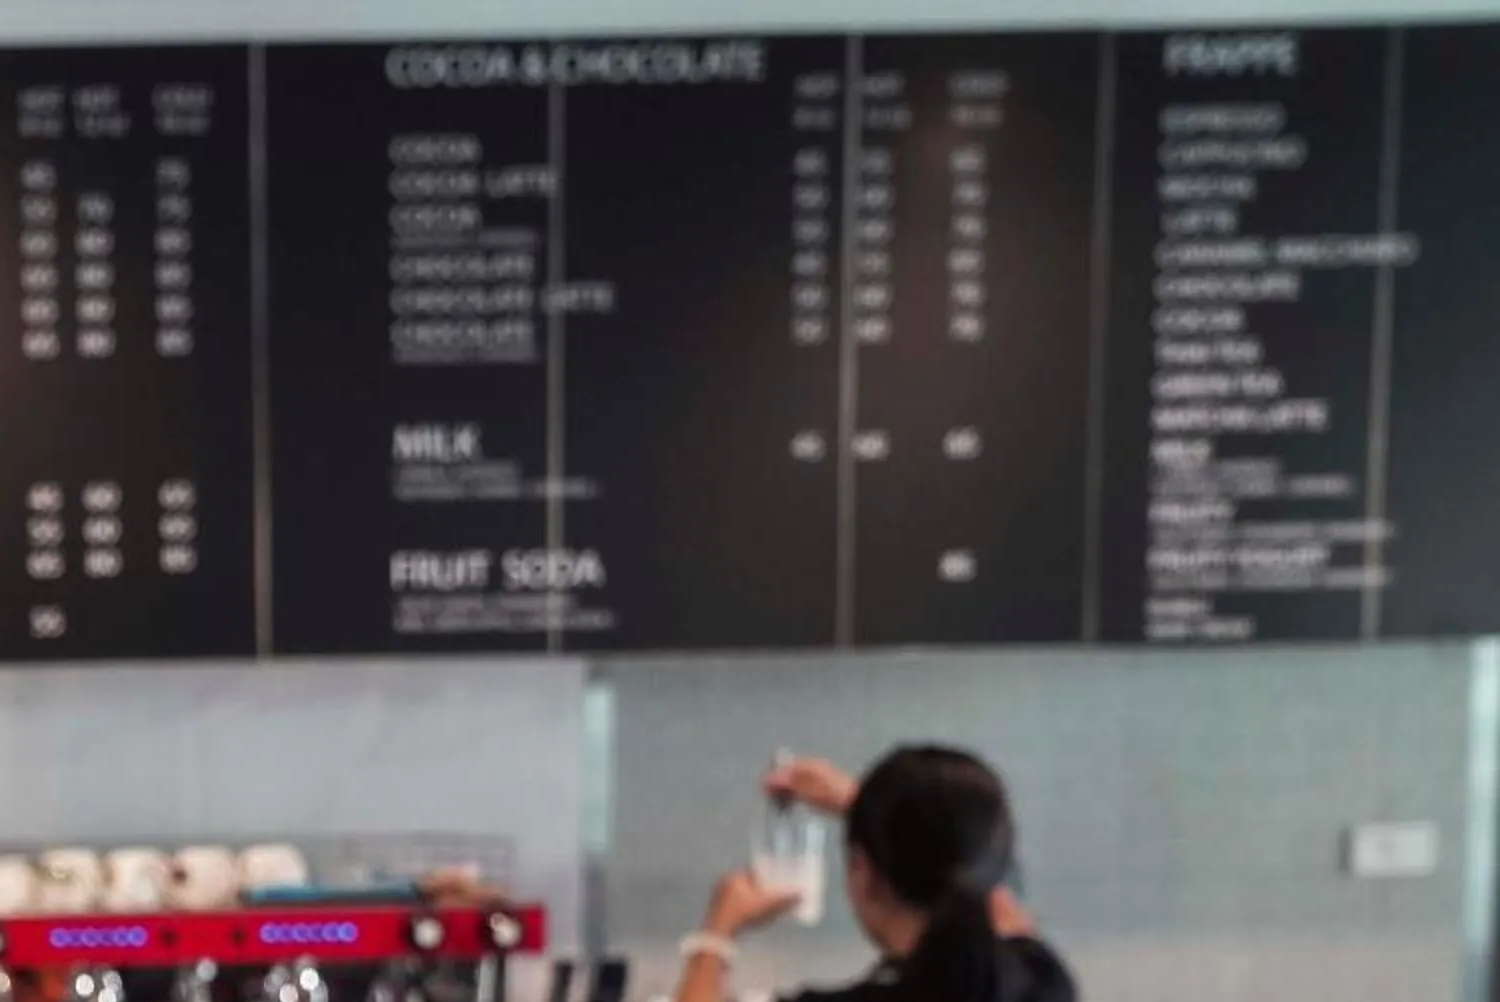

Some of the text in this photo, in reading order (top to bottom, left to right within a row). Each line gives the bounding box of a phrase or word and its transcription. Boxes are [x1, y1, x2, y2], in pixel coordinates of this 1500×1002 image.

[387, 42, 765, 88] COCOA & CHOCOLATE
[389, 135, 482, 165] COCOA
[389, 168, 479, 198] COCOA
[390, 204, 481, 233] COCOA
[393, 423, 481, 461] MILK
[390, 548, 606, 591] FRUIT SODA
